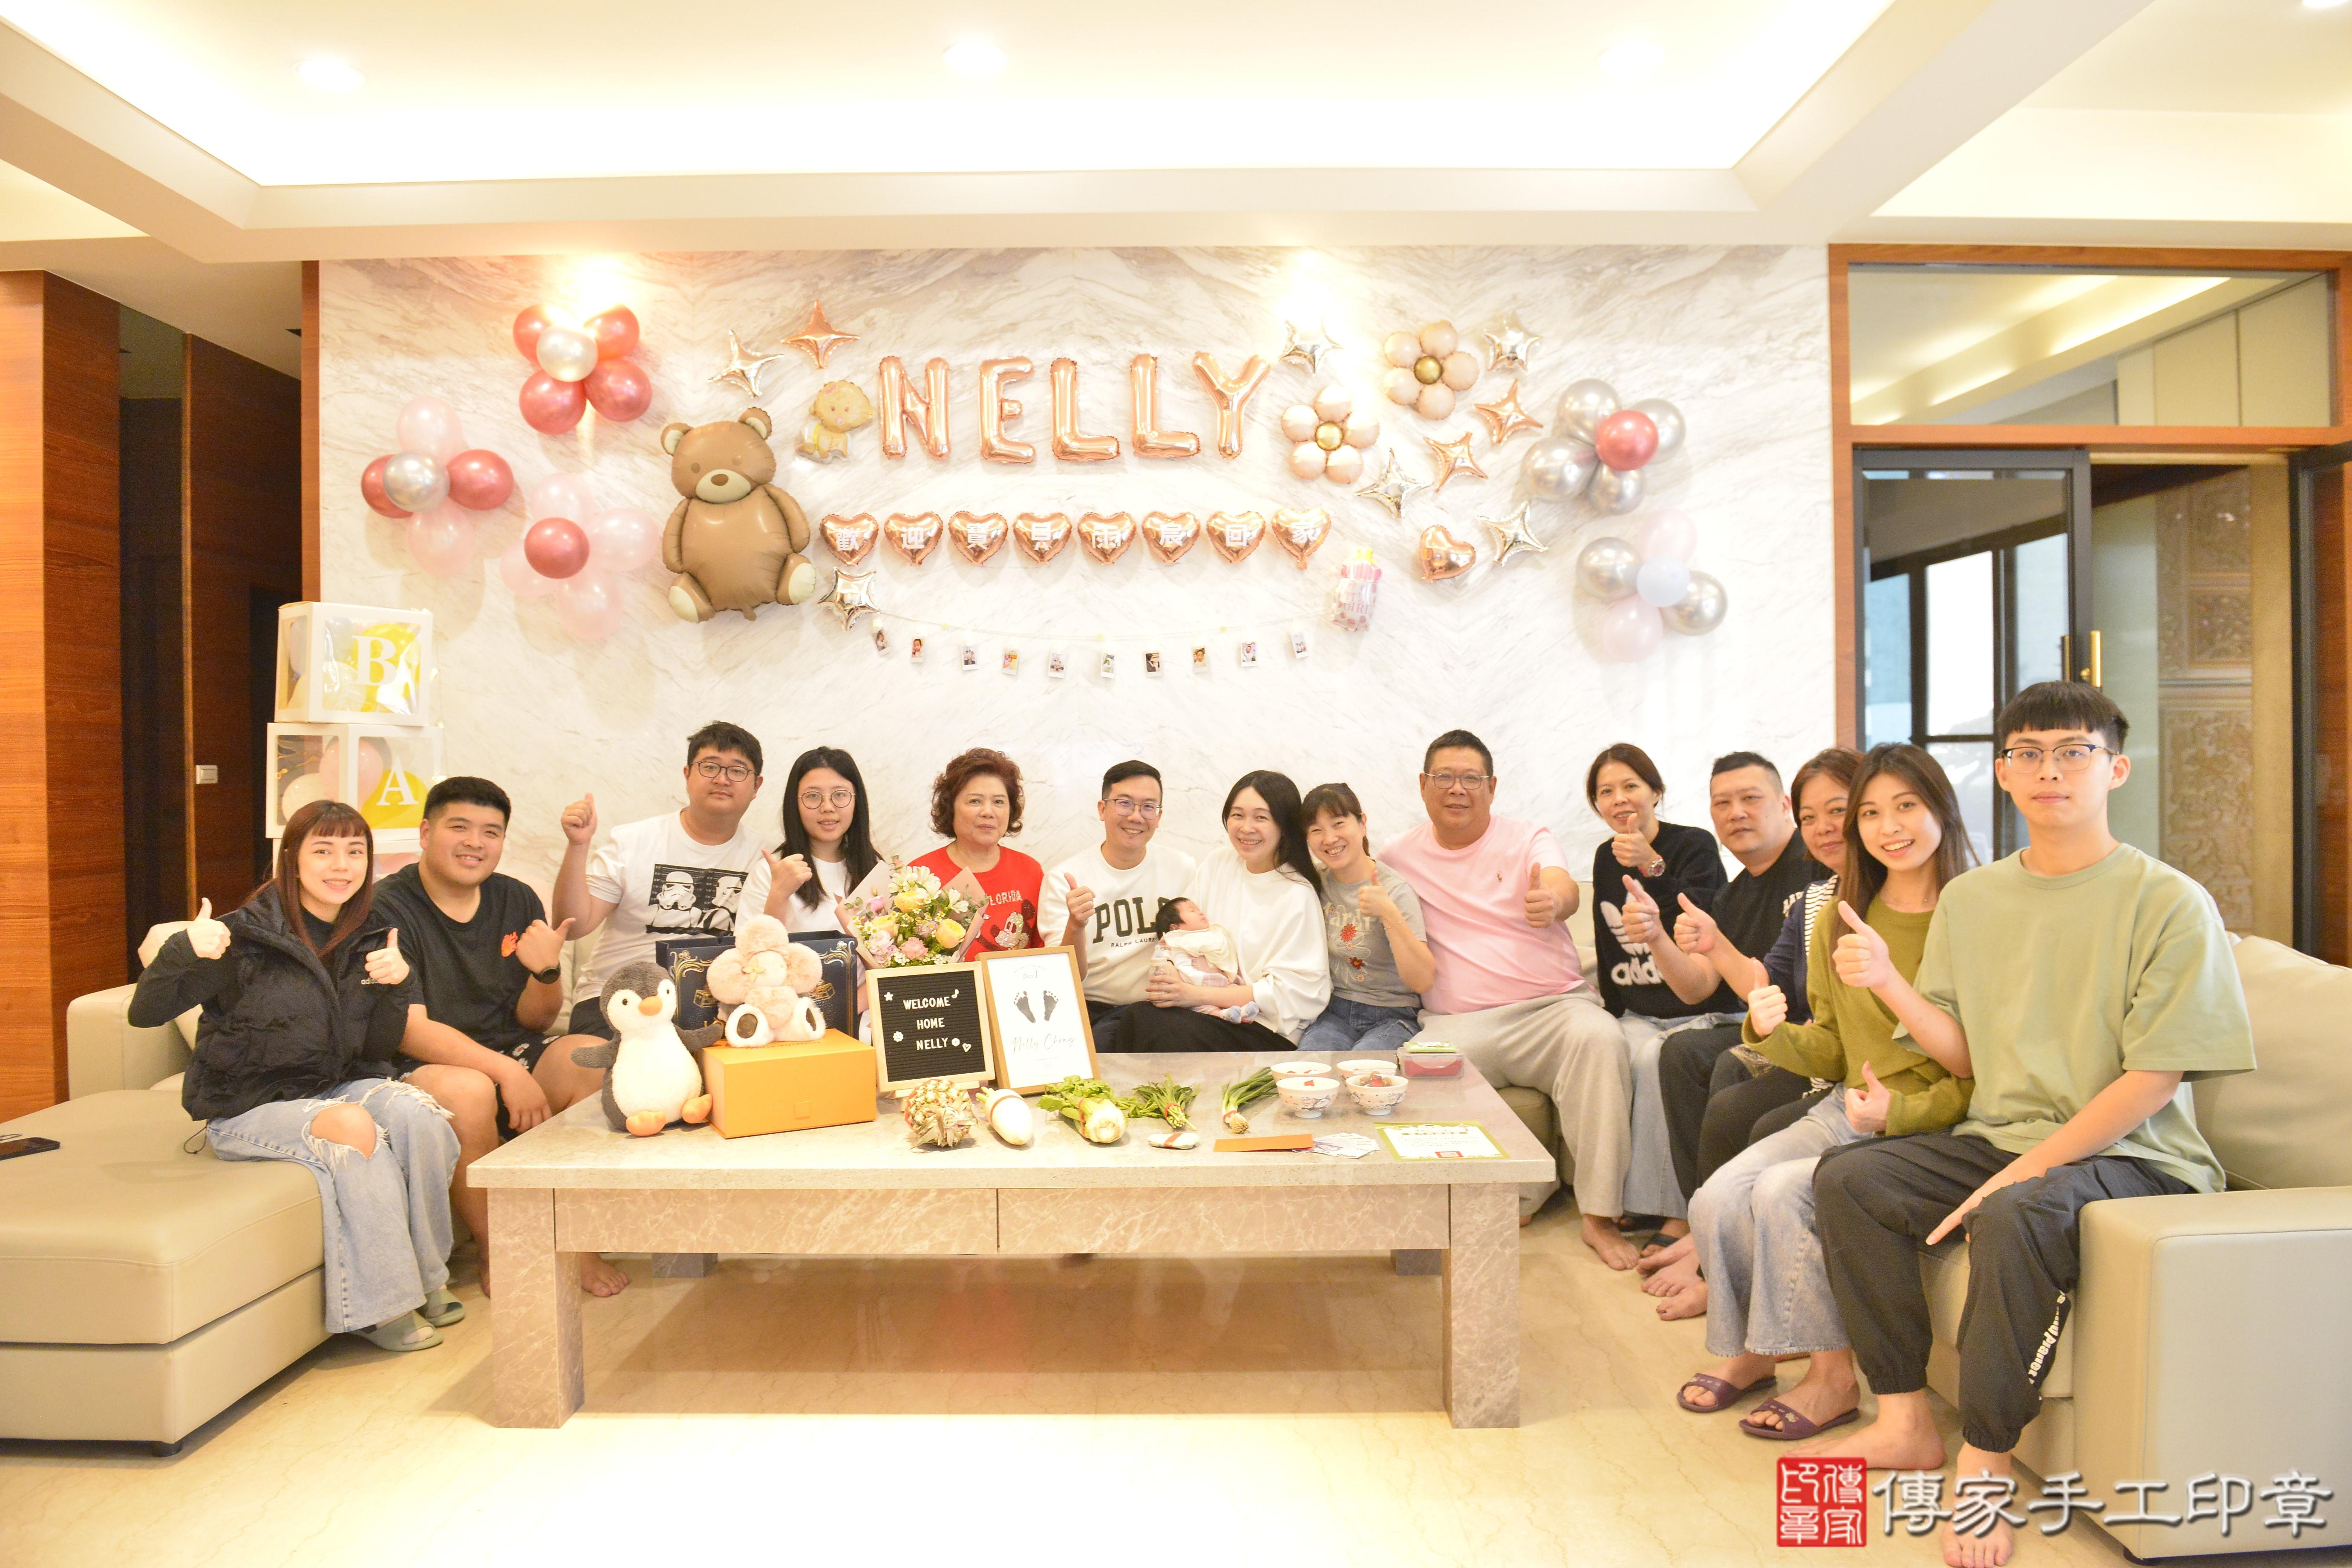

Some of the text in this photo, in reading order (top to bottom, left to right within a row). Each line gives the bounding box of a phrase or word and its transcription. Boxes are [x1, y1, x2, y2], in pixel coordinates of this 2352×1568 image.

[879, 350, 1271, 464] NELLY
[351, 634, 397, 686] B
[376, 755, 419, 806] A
[902, 996, 951, 1010] WELCOME
[916, 1017, 945, 1030] HOME
[916, 1037, 948, 1051] NELLY
